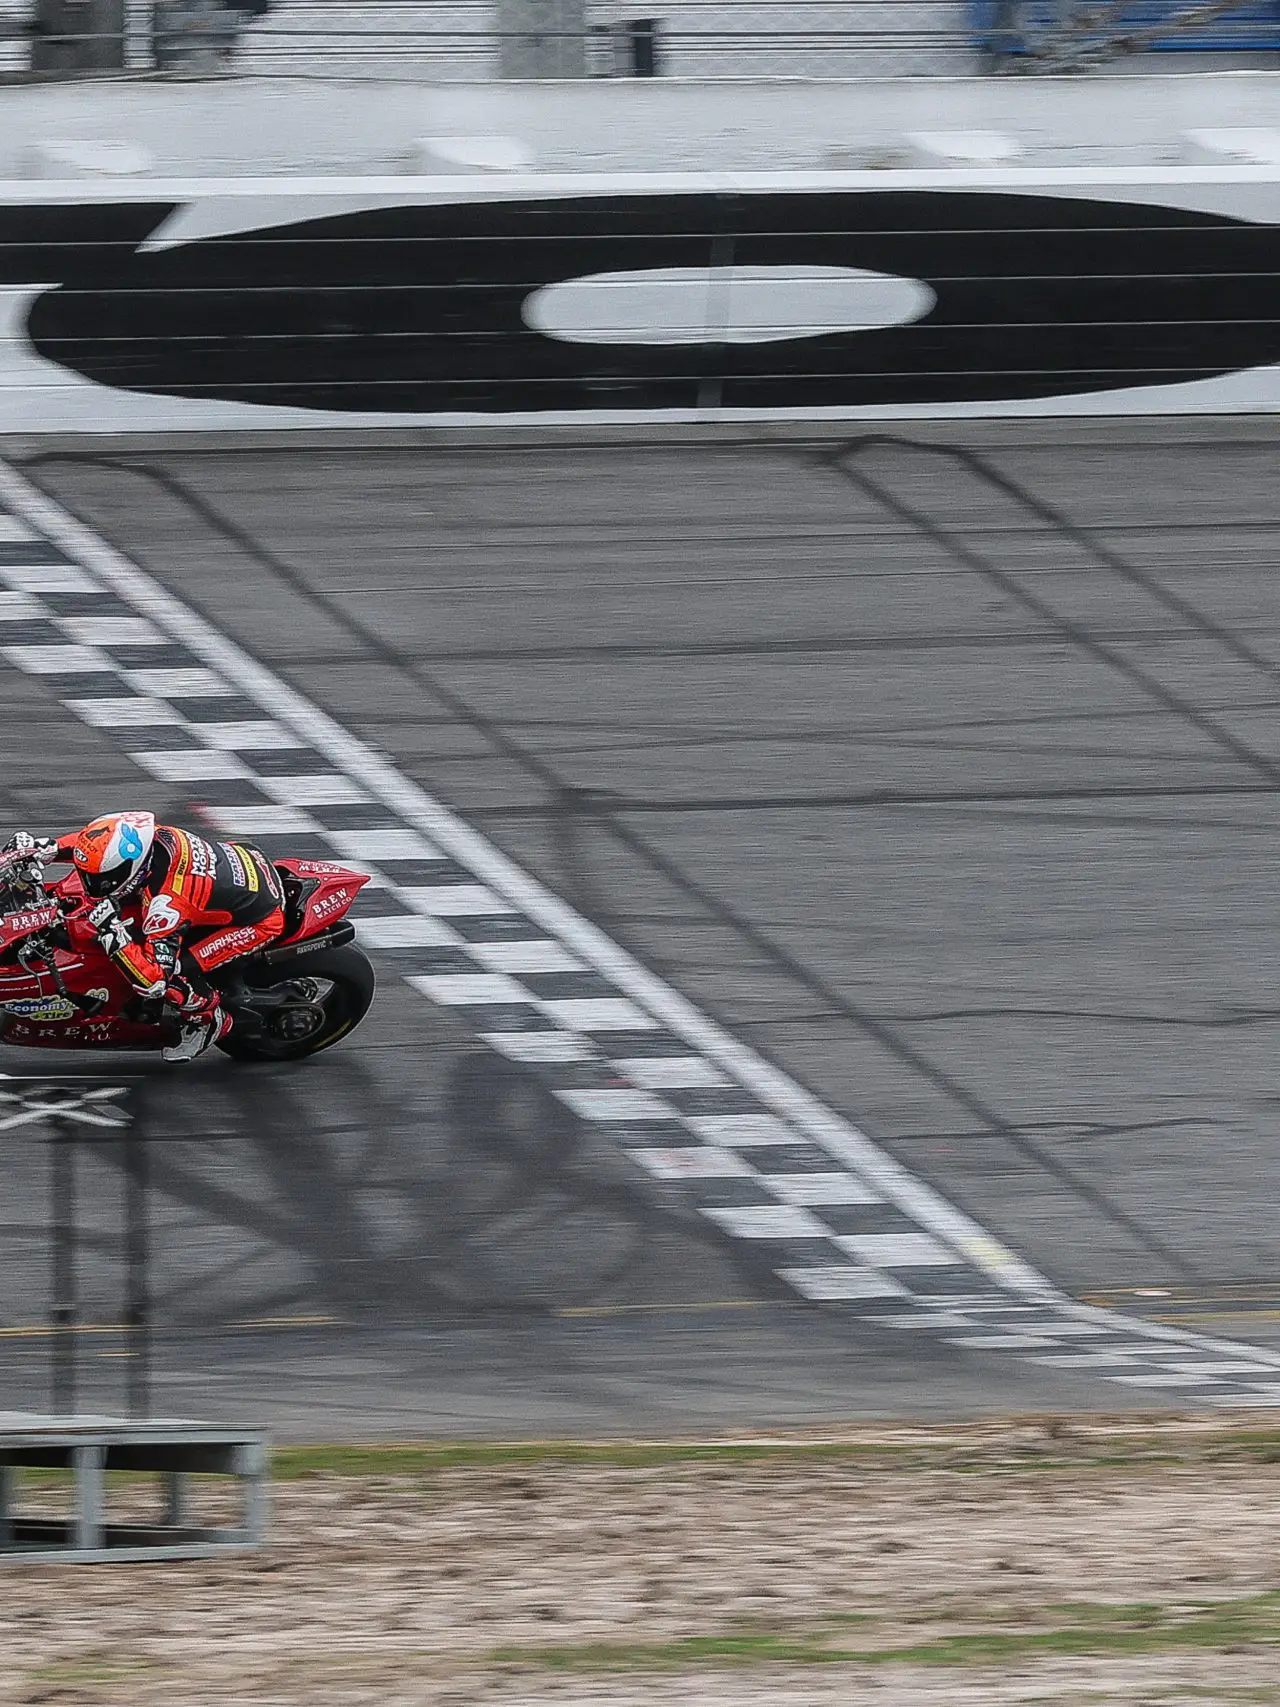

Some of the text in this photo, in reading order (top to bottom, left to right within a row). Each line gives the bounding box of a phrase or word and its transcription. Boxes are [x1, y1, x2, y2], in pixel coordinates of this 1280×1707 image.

[312, 887, 348, 914] BREW
[11, 911, 51, 927] BREW
[198, 926, 256, 959] WARHORSE
[5, 1002, 68, 1012] Economy
[14, 1022, 112, 1038] BREW
